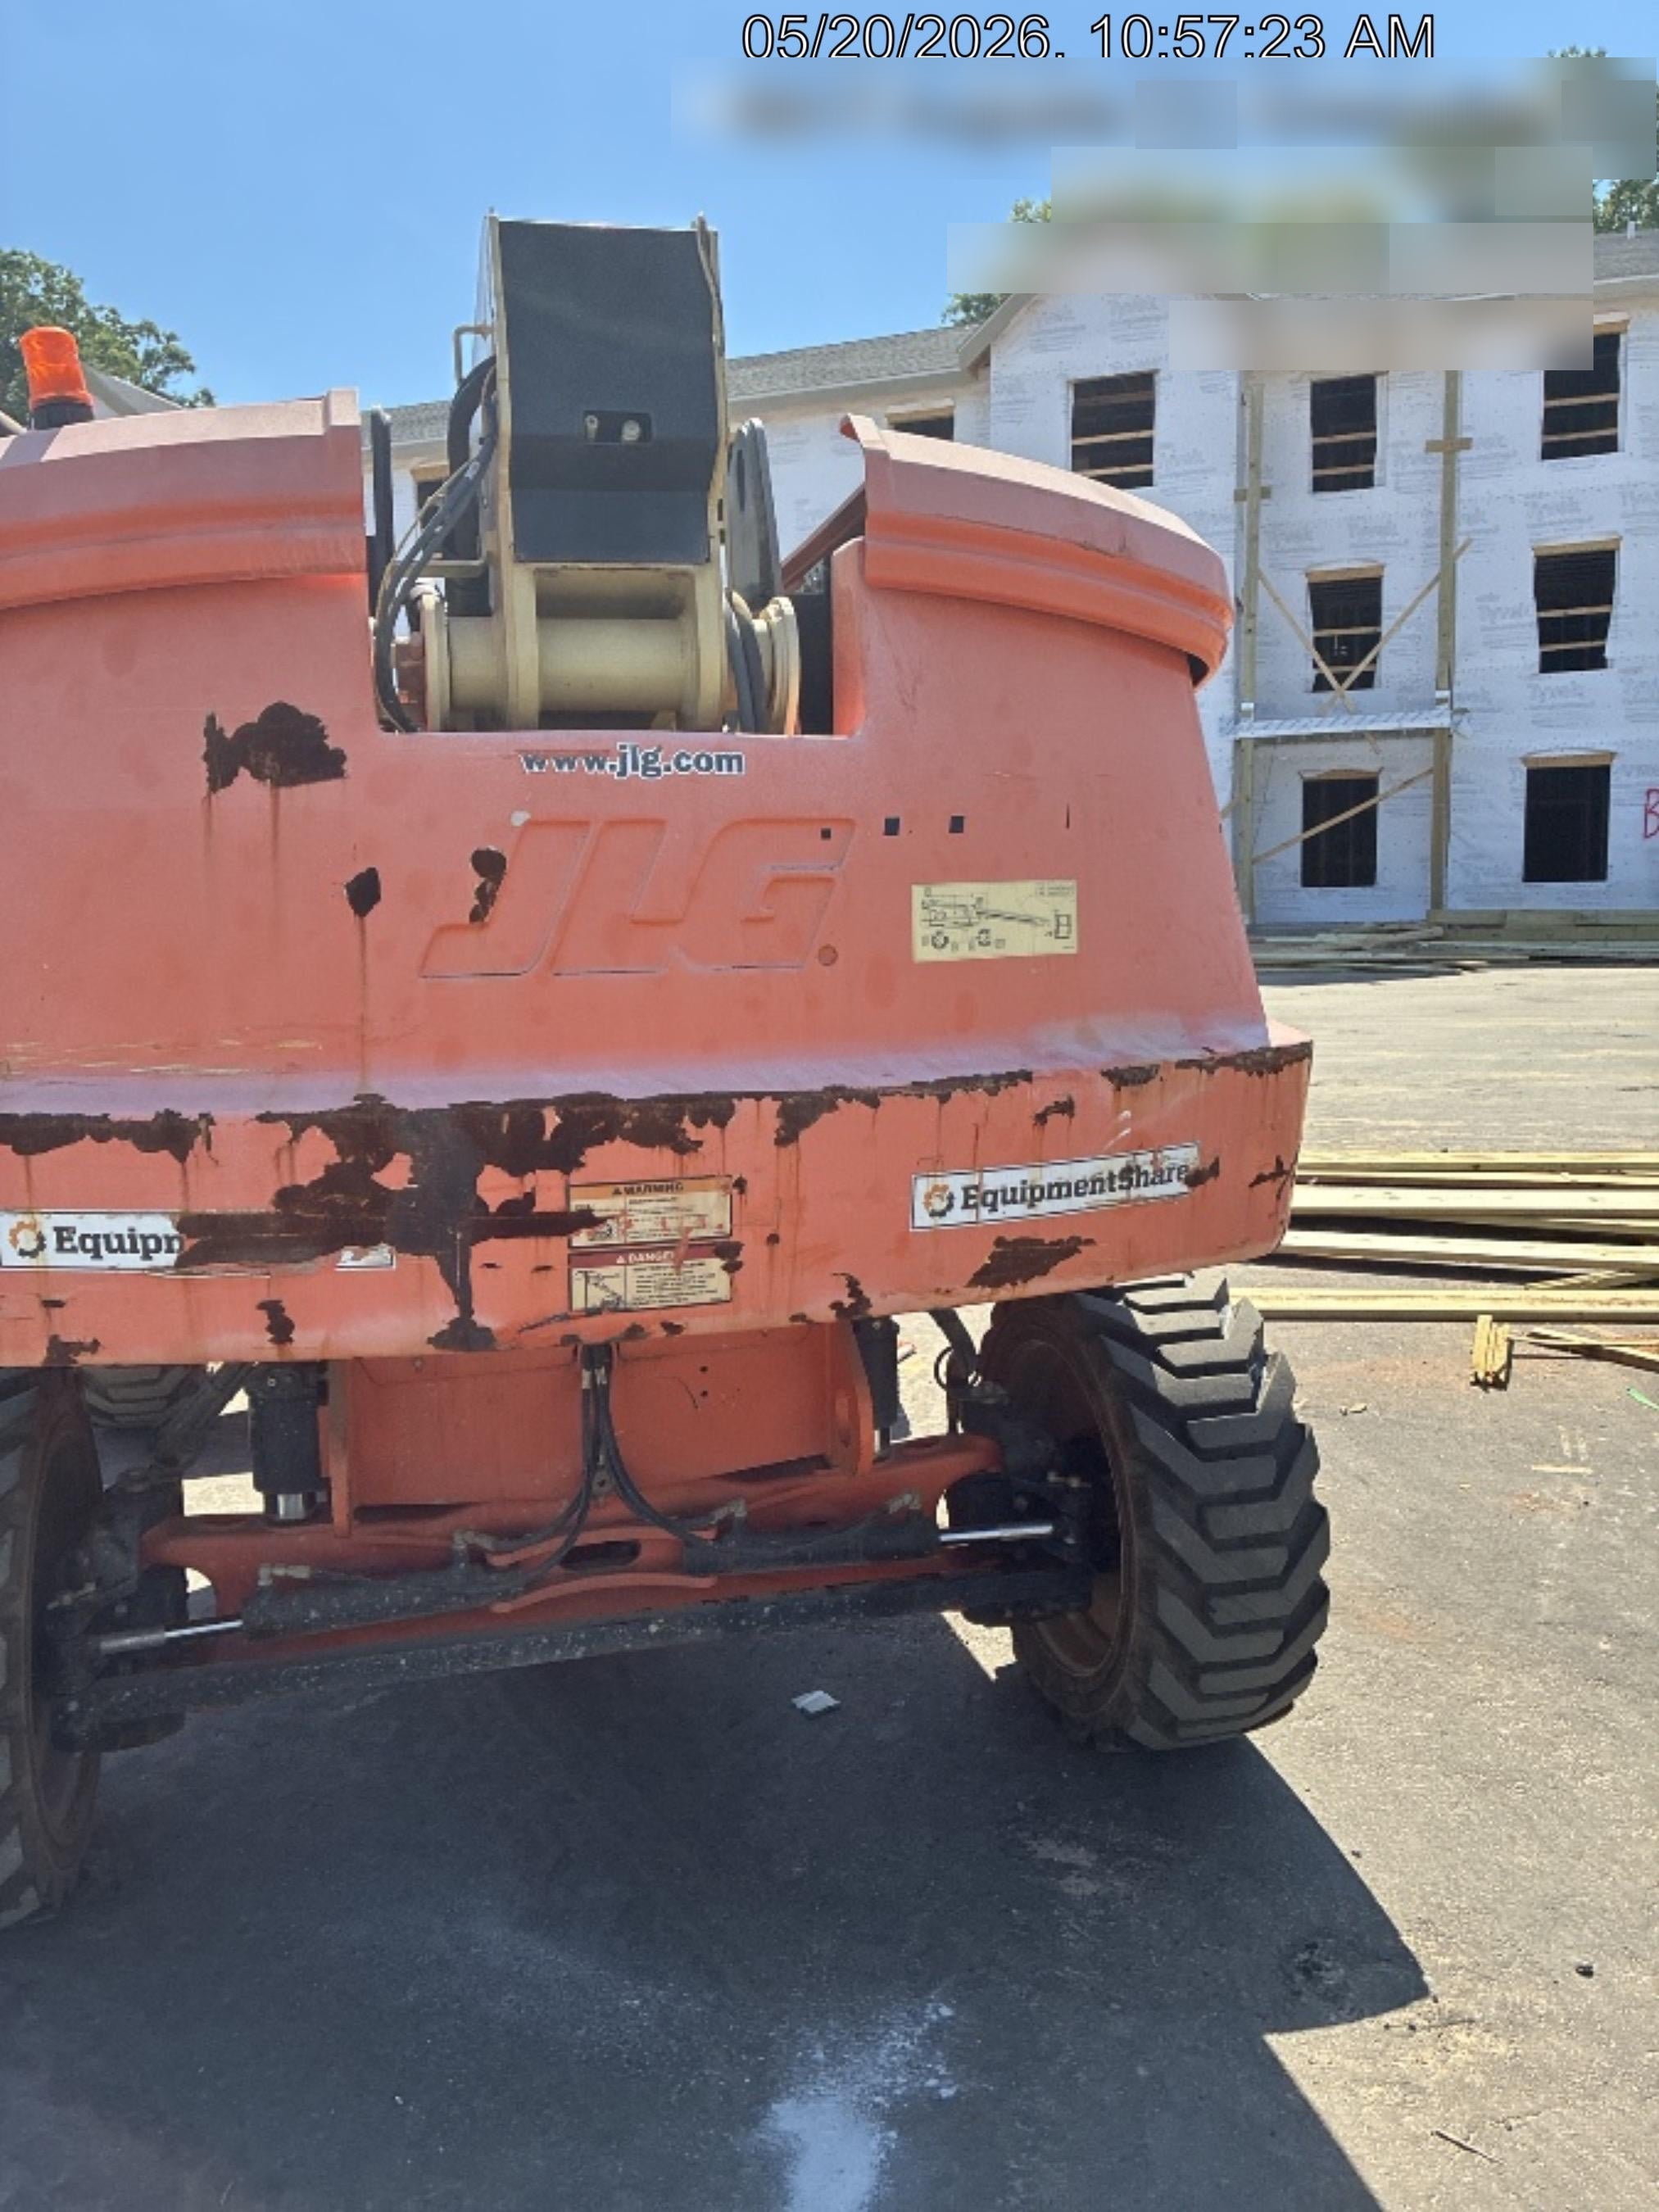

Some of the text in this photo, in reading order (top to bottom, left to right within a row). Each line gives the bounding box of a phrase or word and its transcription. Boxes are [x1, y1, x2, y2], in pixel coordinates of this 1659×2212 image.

[519, 741, 745, 779] www.jlg.com
[419, 818, 856, 978] JLG
[960, 1164, 1188, 1213] EquipmentShare
